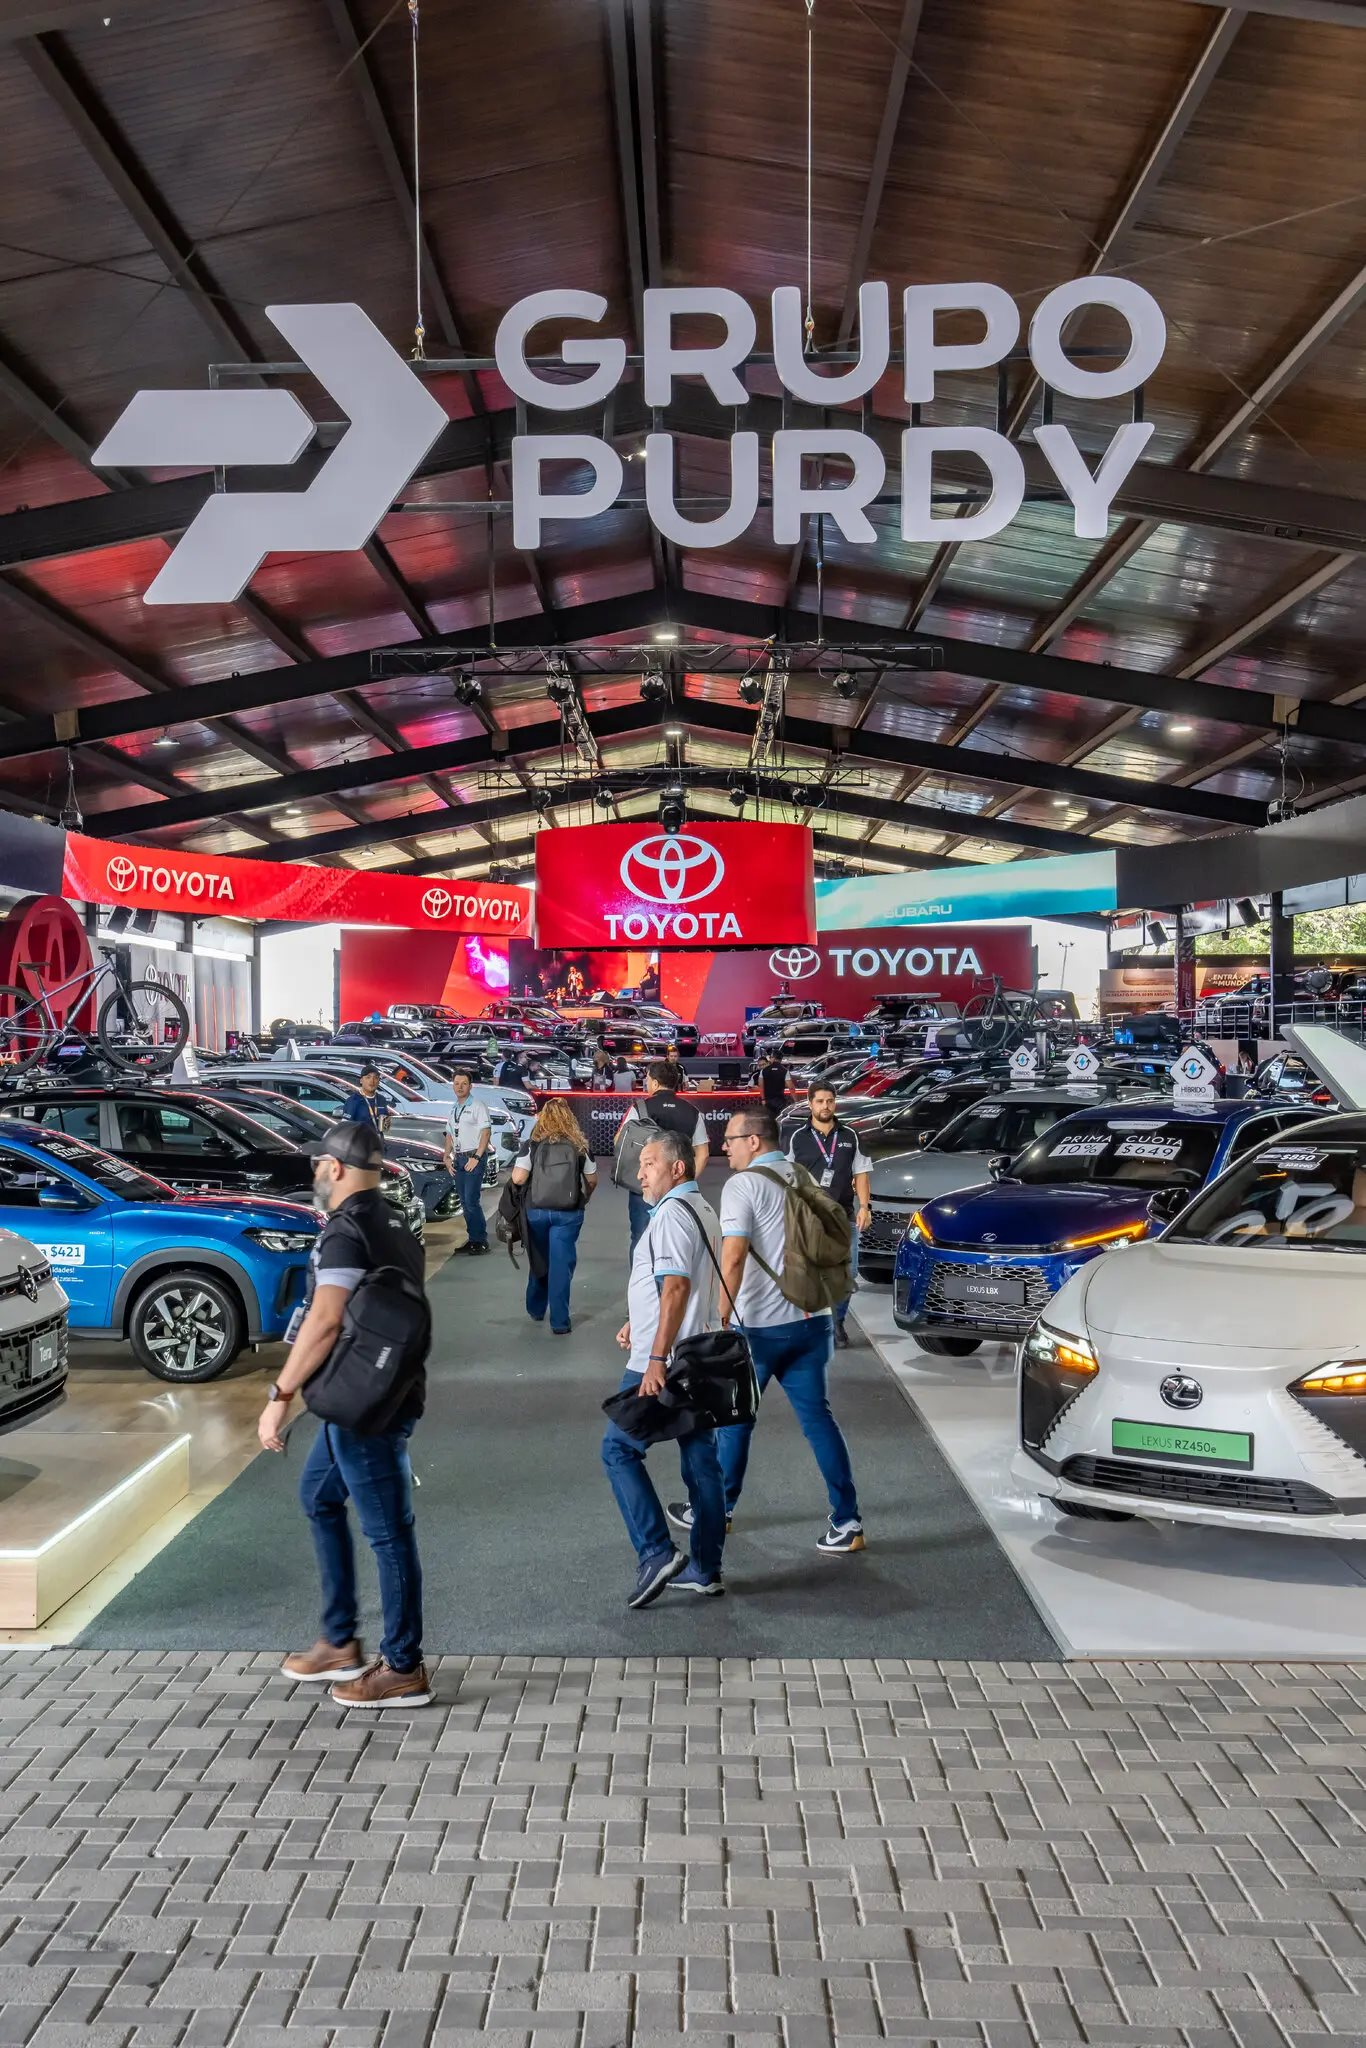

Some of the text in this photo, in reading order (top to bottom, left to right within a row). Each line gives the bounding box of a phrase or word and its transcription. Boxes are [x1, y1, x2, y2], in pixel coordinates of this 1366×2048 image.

[494, 275, 1167, 410] GRUPO
[511, 421, 1156, 550] PURDY
[138, 865, 234, 900] TOYOTA
[453, 894, 521, 922] TOYOTA
[603, 912, 743, 941] TOYOTA
[828, 947, 983, 977] TOYOTA
[591, 1109, 732, 1121] Centr nción
[1060, 1135, 1183, 1147] PRIMA CUOTA
[1058, 1145, 1174, 1157] 10% $649
[50, 1246, 81, 1258] $421
[966, 1285, 999, 1295] LEXUS LBX
[40, 1346, 52, 1362] Tera
[1141, 1435, 1217, 1454] LEXUS RZ450e
